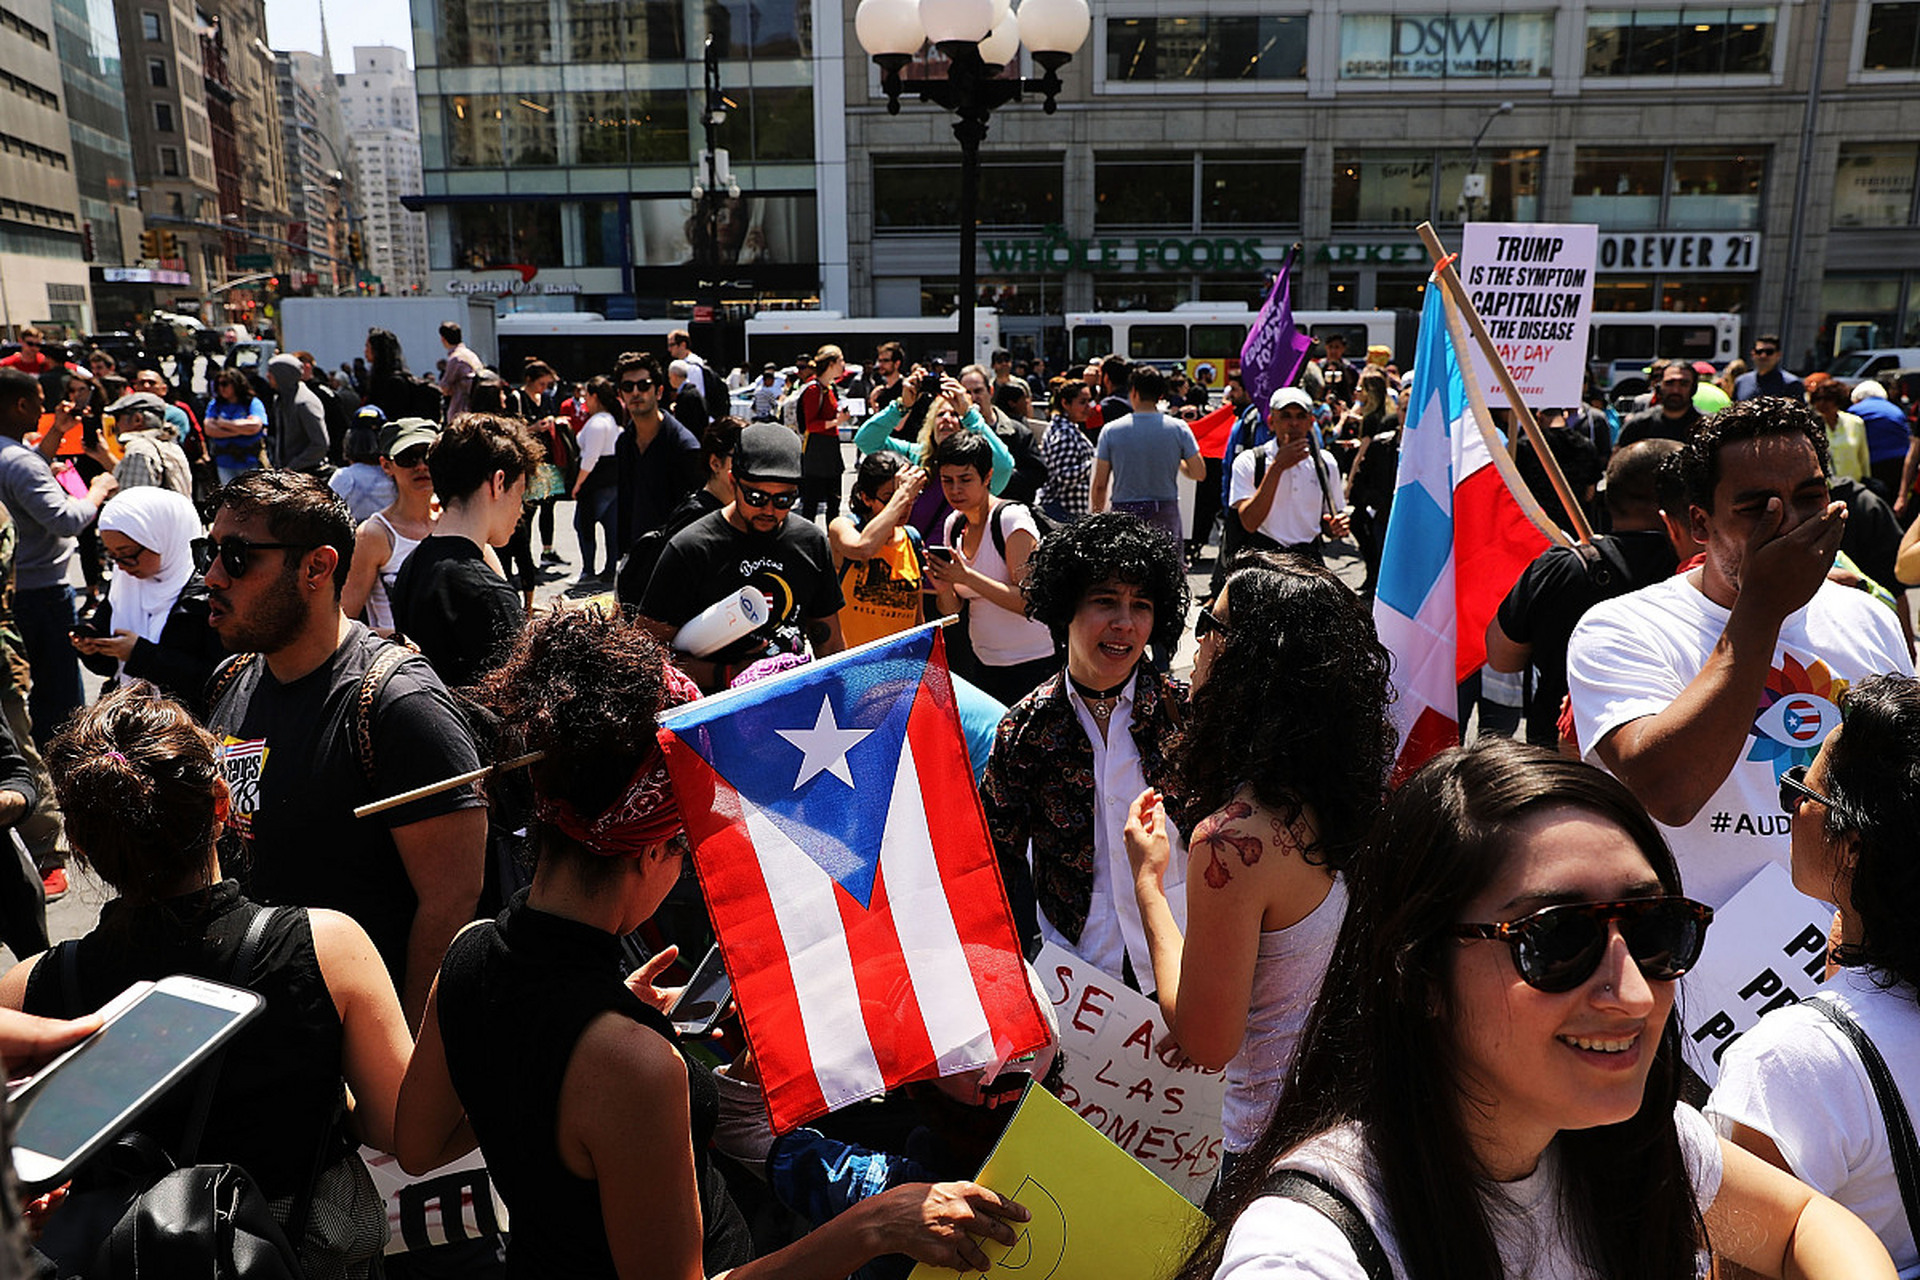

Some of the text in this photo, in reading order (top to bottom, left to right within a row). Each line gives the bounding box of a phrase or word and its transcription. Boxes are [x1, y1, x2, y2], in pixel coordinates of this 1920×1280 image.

[1393, 17, 1497, 56] DSW
[982, 239, 1122, 273] WHOLE
[1134, 238, 1263, 271] FOODS
[1496, 236, 1564, 263] TRUMP
[1601, 236, 1753, 268] OREVER 21
[543, 283, 582, 293] Bank
[1469, 265, 1587, 288] IS THE SYMPTOM
[1471, 290, 1582, 319] CAPITALISM
[1490, 319, 1518, 339] THE
[1518, 321, 1575, 341] DISEASE
[1496, 343, 1554, 364] AY DAY
[739, 557, 784, 577] Boricua
[1052, 966, 1115, 1035] SE
[1095, 1060, 1185, 1114] LAS
